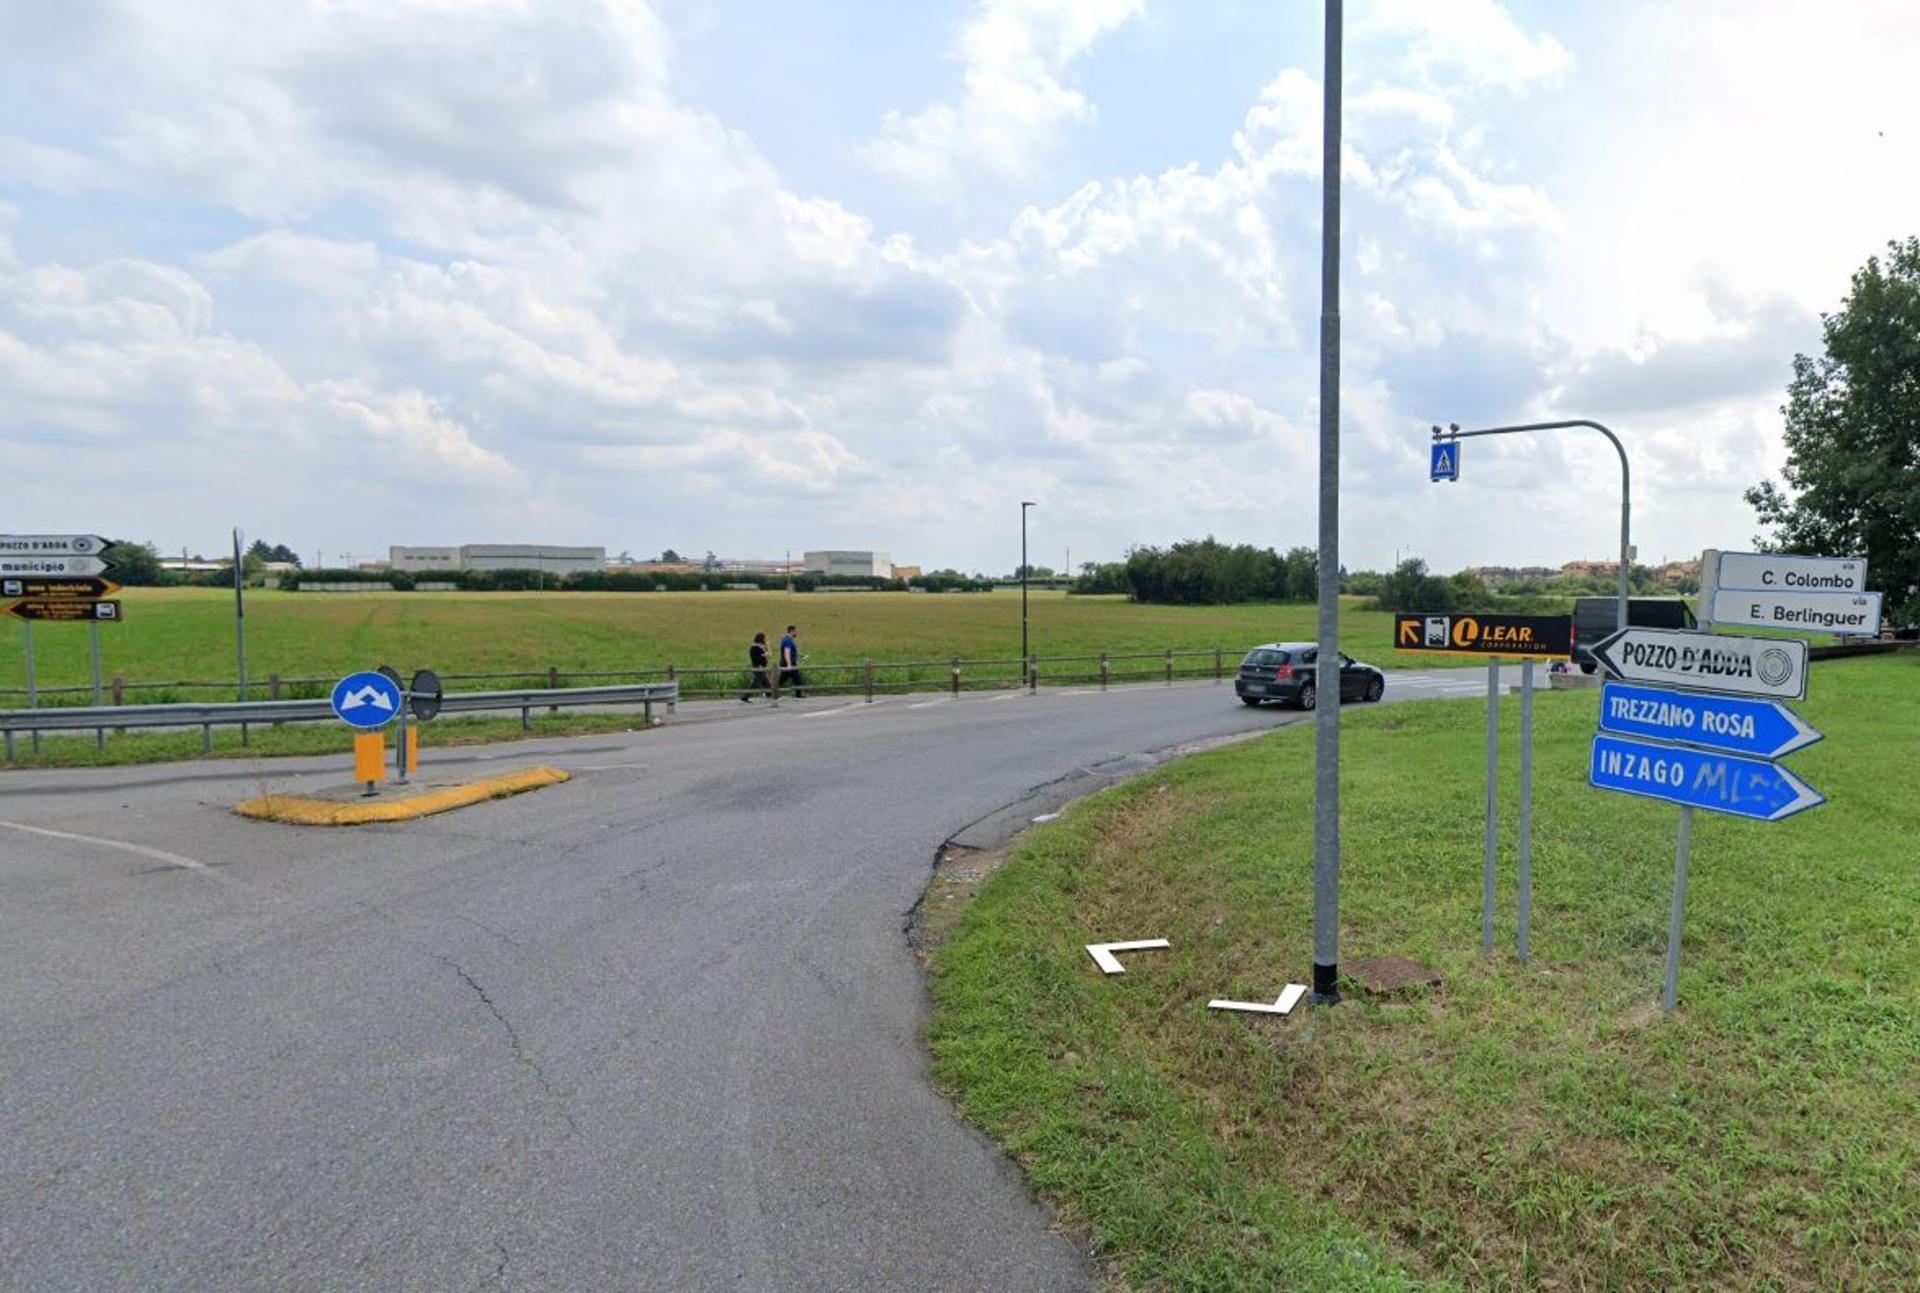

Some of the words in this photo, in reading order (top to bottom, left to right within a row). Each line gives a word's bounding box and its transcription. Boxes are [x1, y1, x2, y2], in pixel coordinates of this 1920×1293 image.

[0, 542, 29, 550] POZZO
[2, 561, 65, 573] municipio
[1762, 570, 1777, 585] C.
[1785, 571, 1854, 588] Colombo
[1852, 597, 1867, 606] via
[1751, 604, 1765, 619] E.
[1774, 606, 1866, 626] Berlinguer
[1482, 625, 1533, 642] LEAR
[1622, 642, 1677, 669] POZZO
[1681, 646, 1753, 678] D'ADDA
[1609, 696, 1695, 728] TREZZANO
[1702, 711, 1755, 740] ROSA
[1601, 749, 1684, 787] INZAGO
